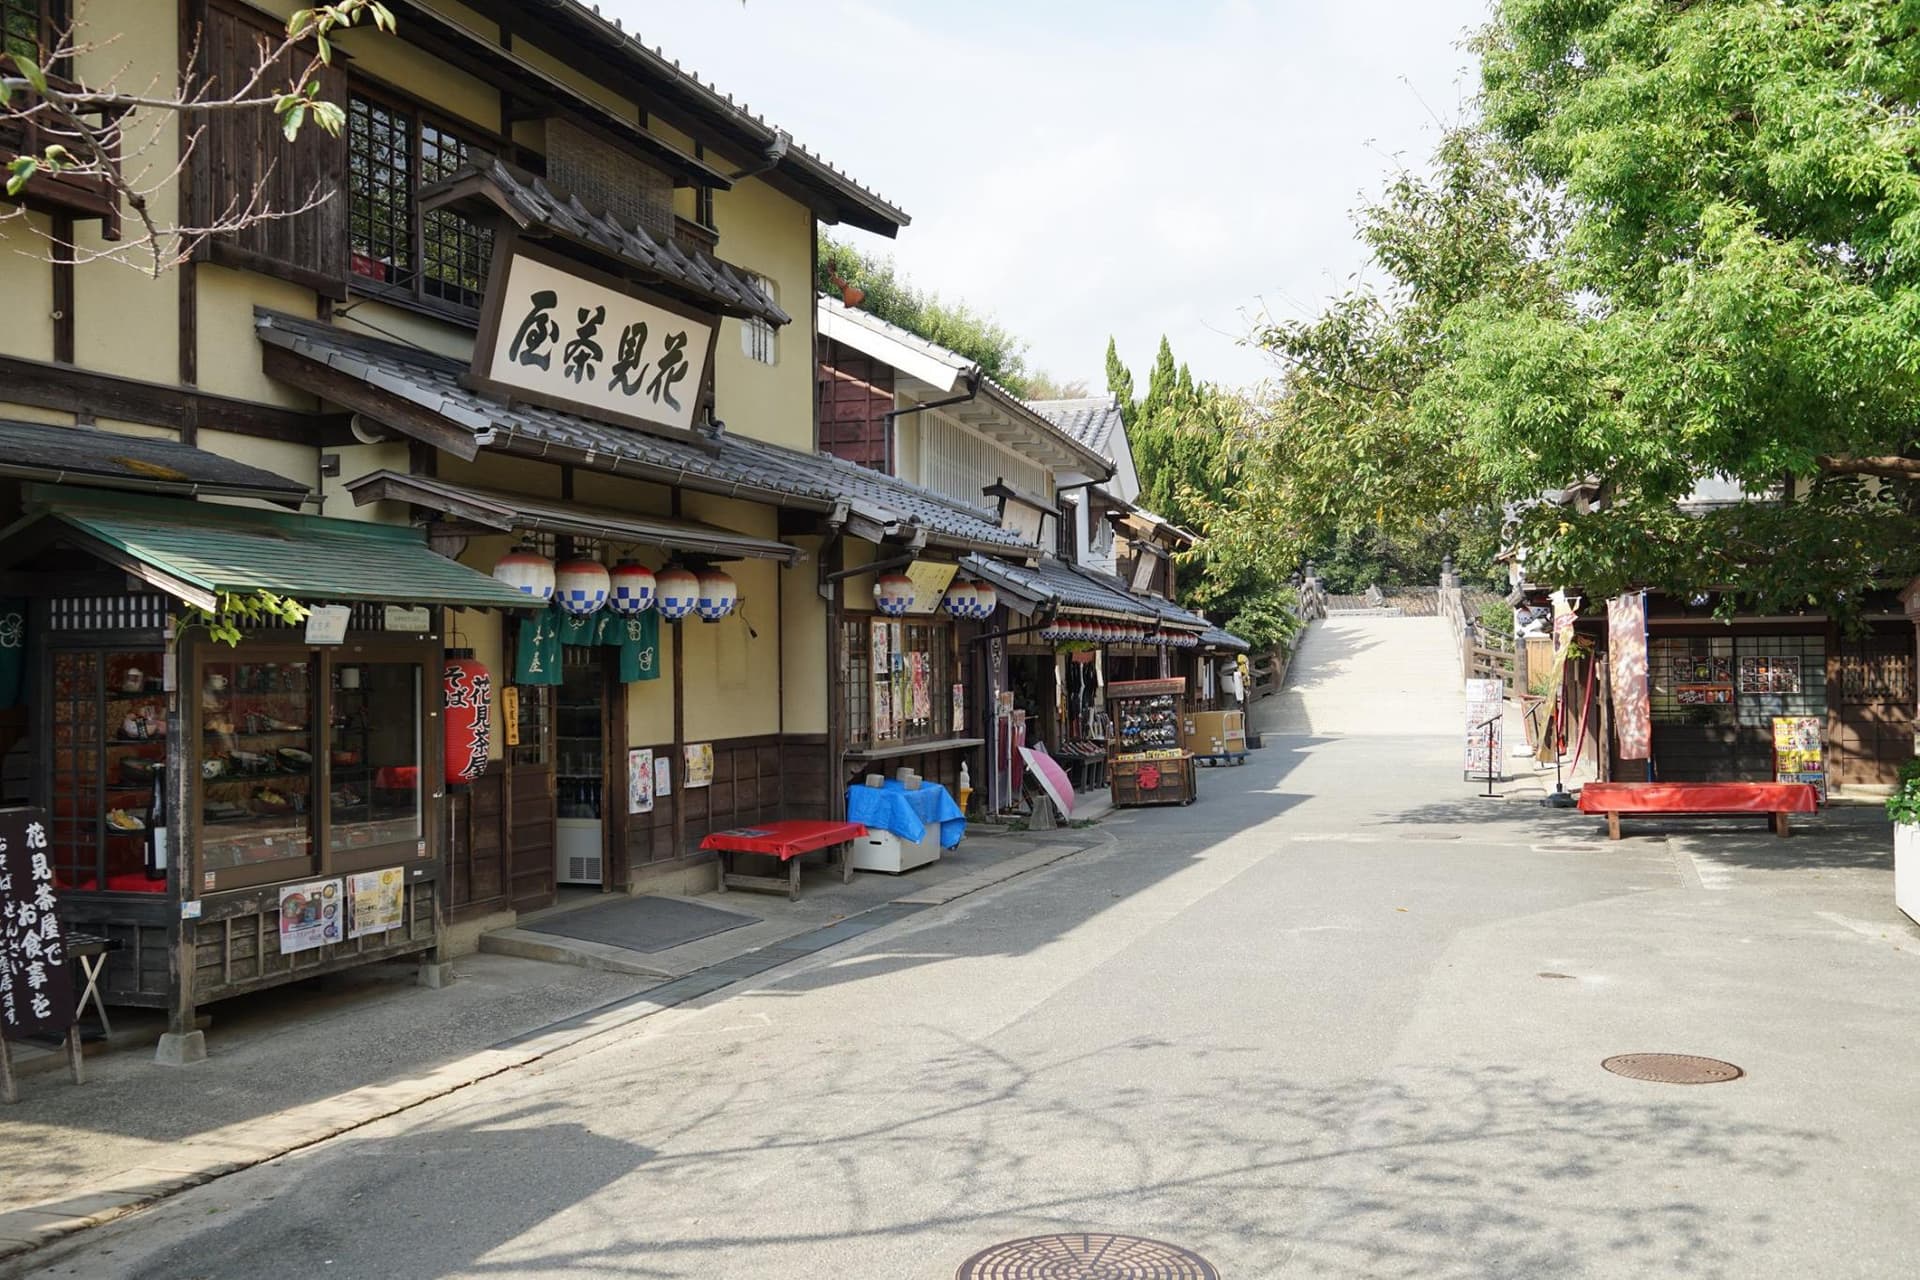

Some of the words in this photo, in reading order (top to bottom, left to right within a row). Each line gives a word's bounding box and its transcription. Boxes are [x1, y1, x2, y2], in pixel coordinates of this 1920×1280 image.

[444, 665, 470, 709] そば
[458, 674, 491, 779] 花見茶屋
[26, 821, 62, 967] 花見茶屋で
[17, 900, 51, 1019] お食事を
